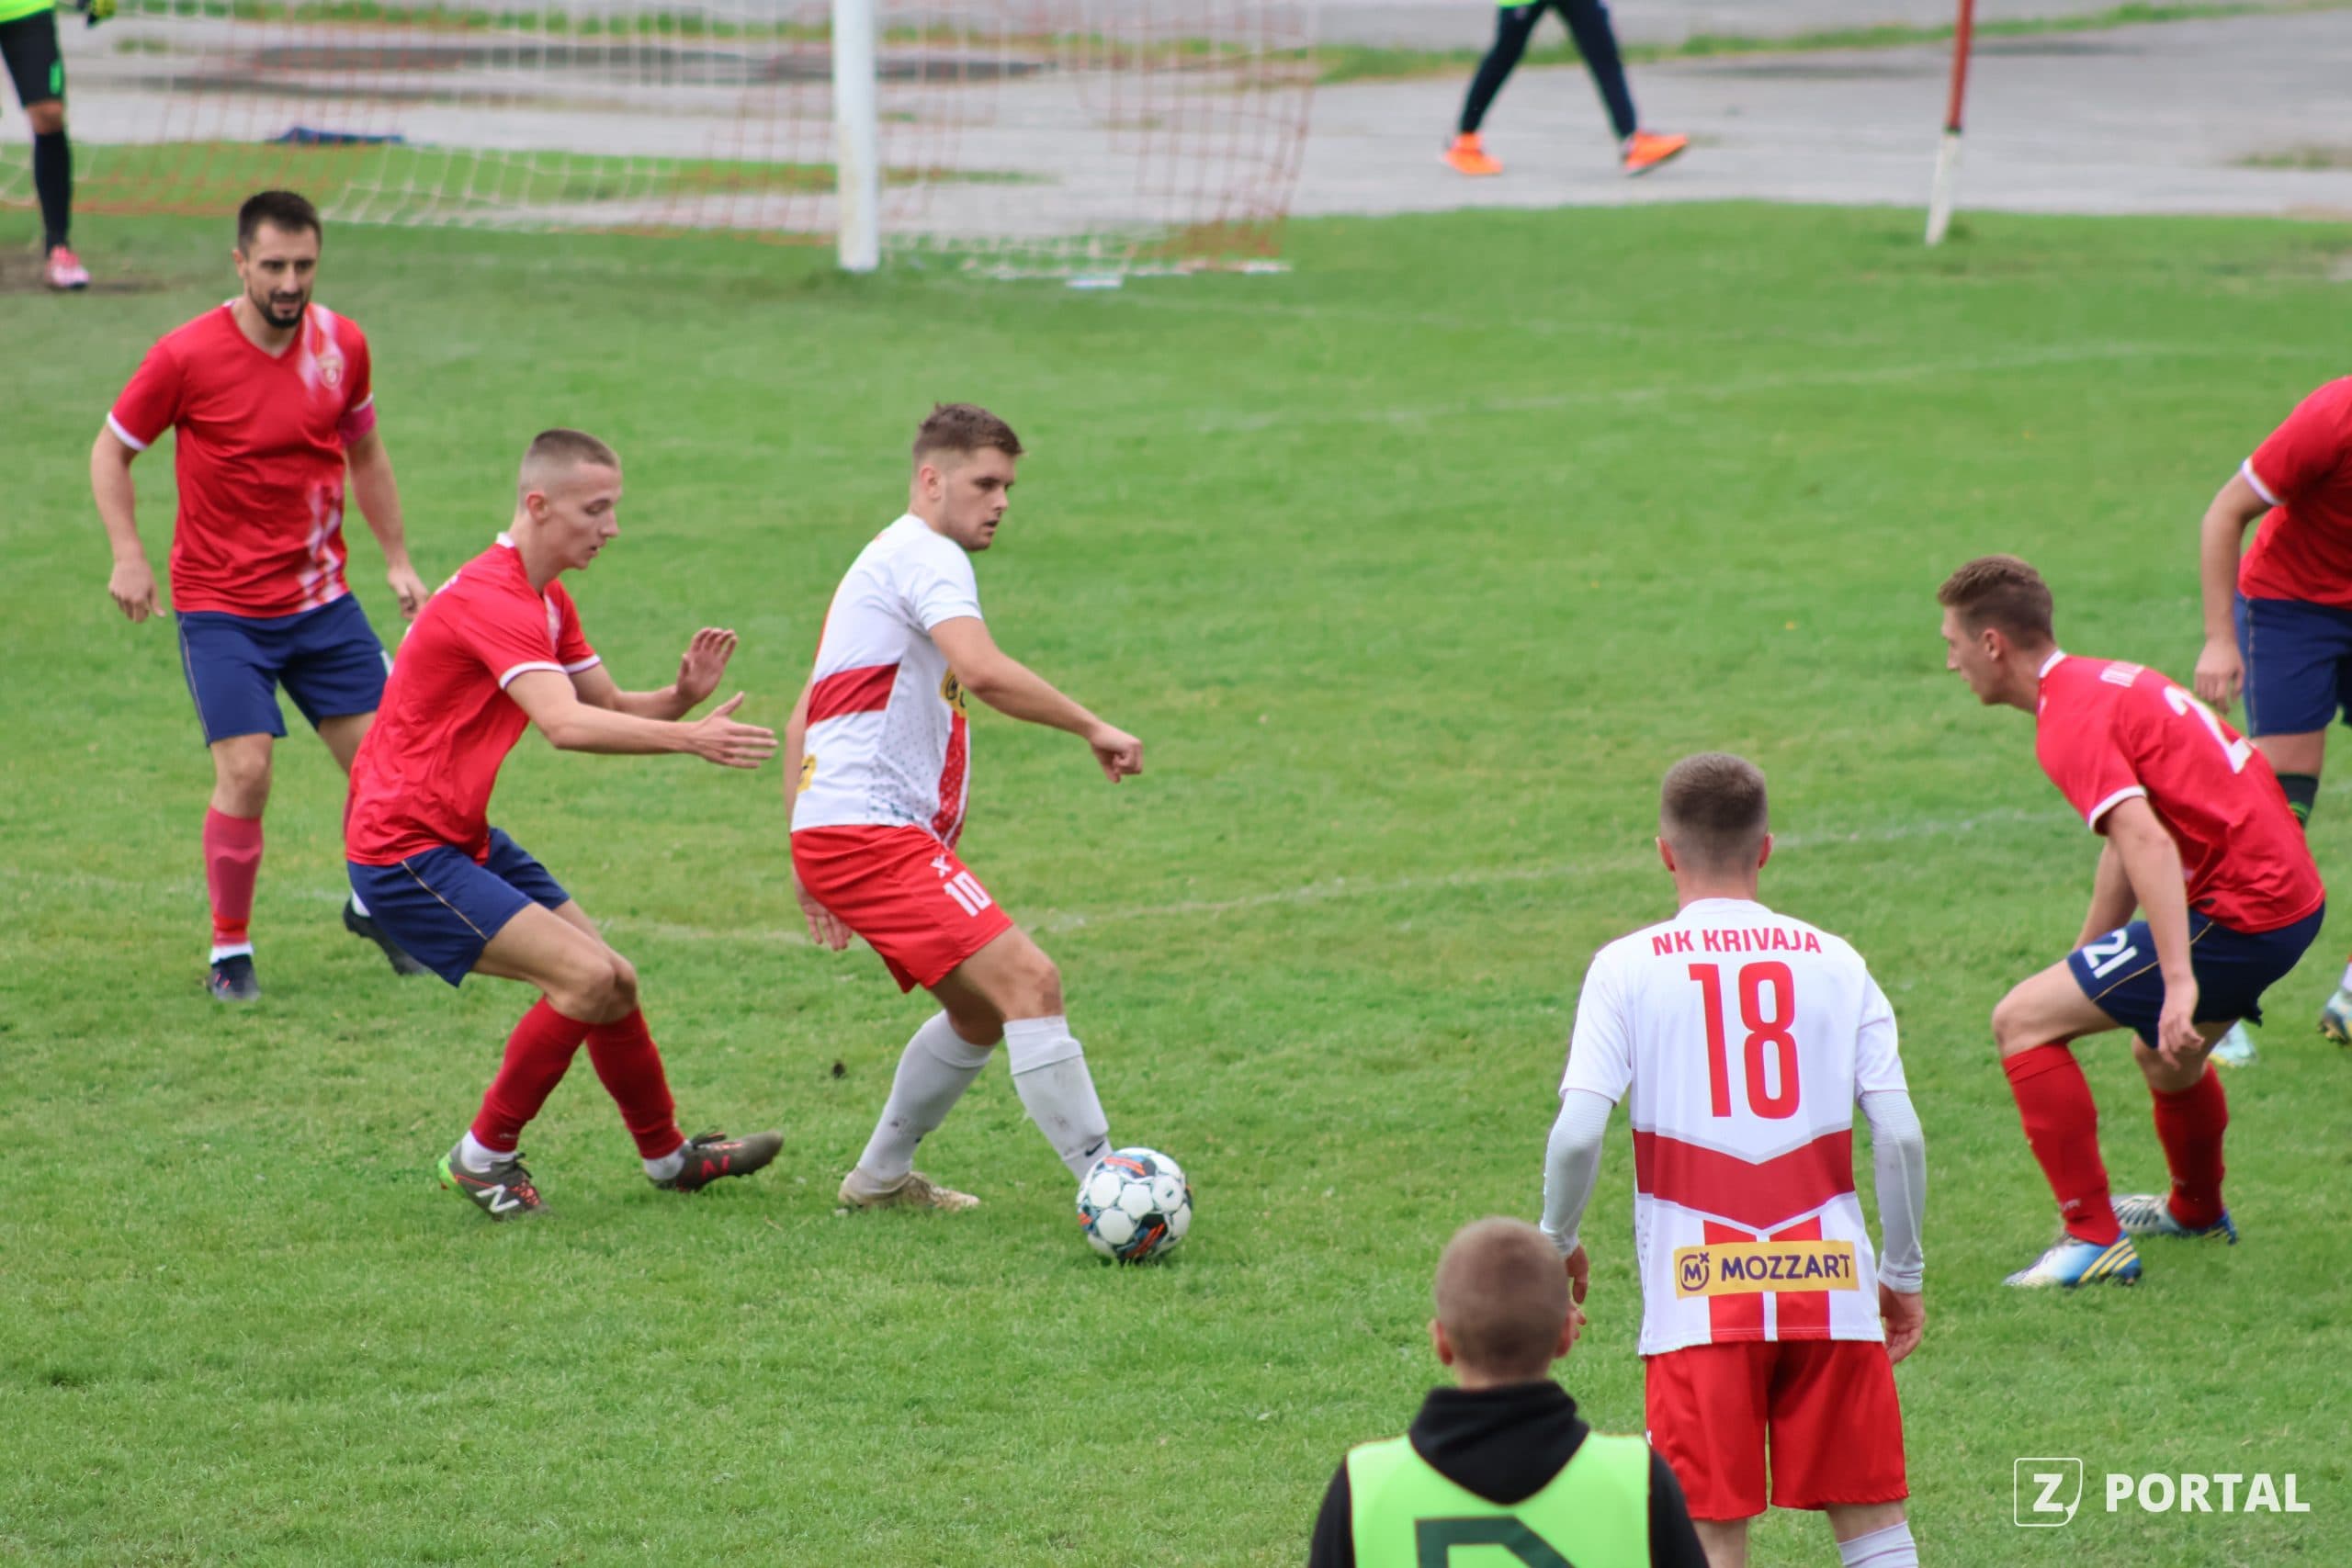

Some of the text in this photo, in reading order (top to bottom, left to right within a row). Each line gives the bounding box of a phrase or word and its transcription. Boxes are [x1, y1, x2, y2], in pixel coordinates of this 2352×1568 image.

[2164, 685, 2256, 774] 2
[943, 870, 993, 917] 10
[1652, 928, 1823, 956] NK KRIVAJA
[2082, 928, 2137, 979] 21
[1688, 961, 1801, 1120] 18
[1721, 1254, 1850, 1281] MOZZART
